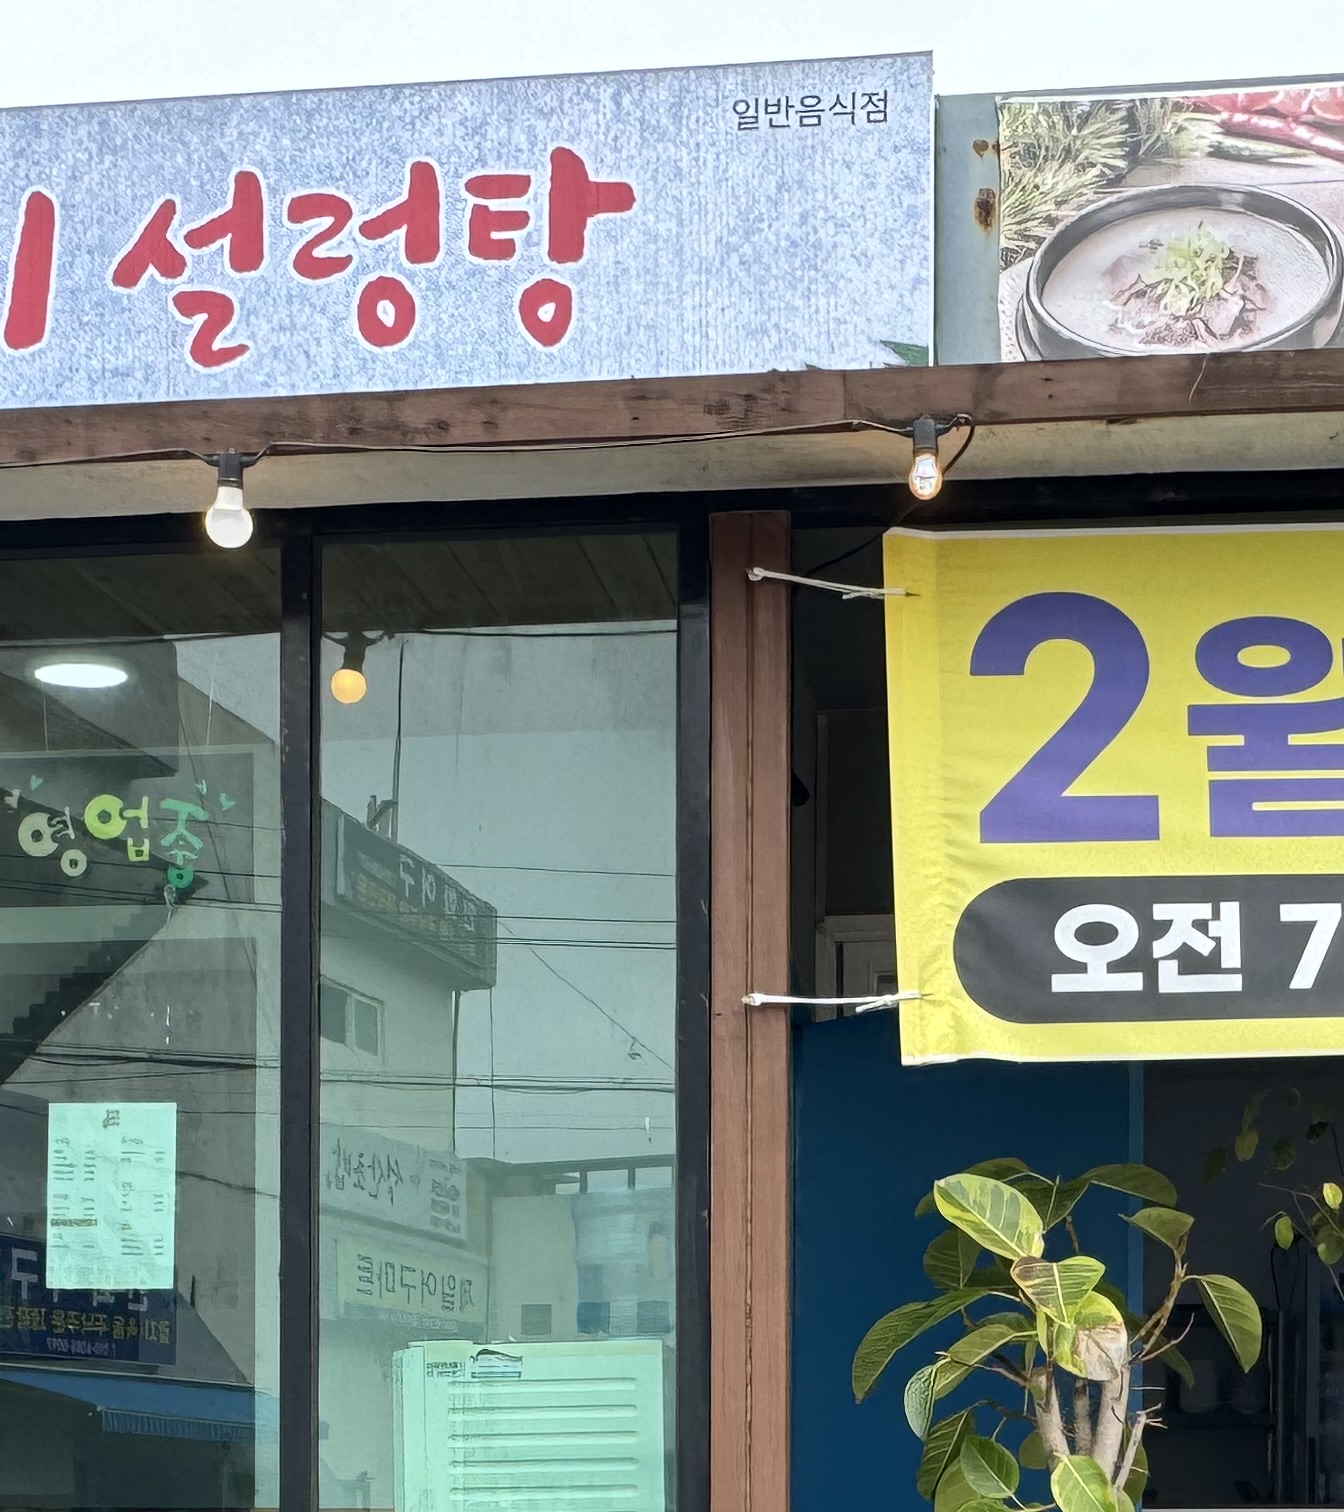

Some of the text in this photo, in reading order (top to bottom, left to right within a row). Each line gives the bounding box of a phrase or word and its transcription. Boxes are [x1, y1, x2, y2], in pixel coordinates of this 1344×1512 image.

[731, 88, 890, 131] 일반음식점
[112, 147, 636, 368] 설렁탕
[1051, 901, 1244, 995] 오전
